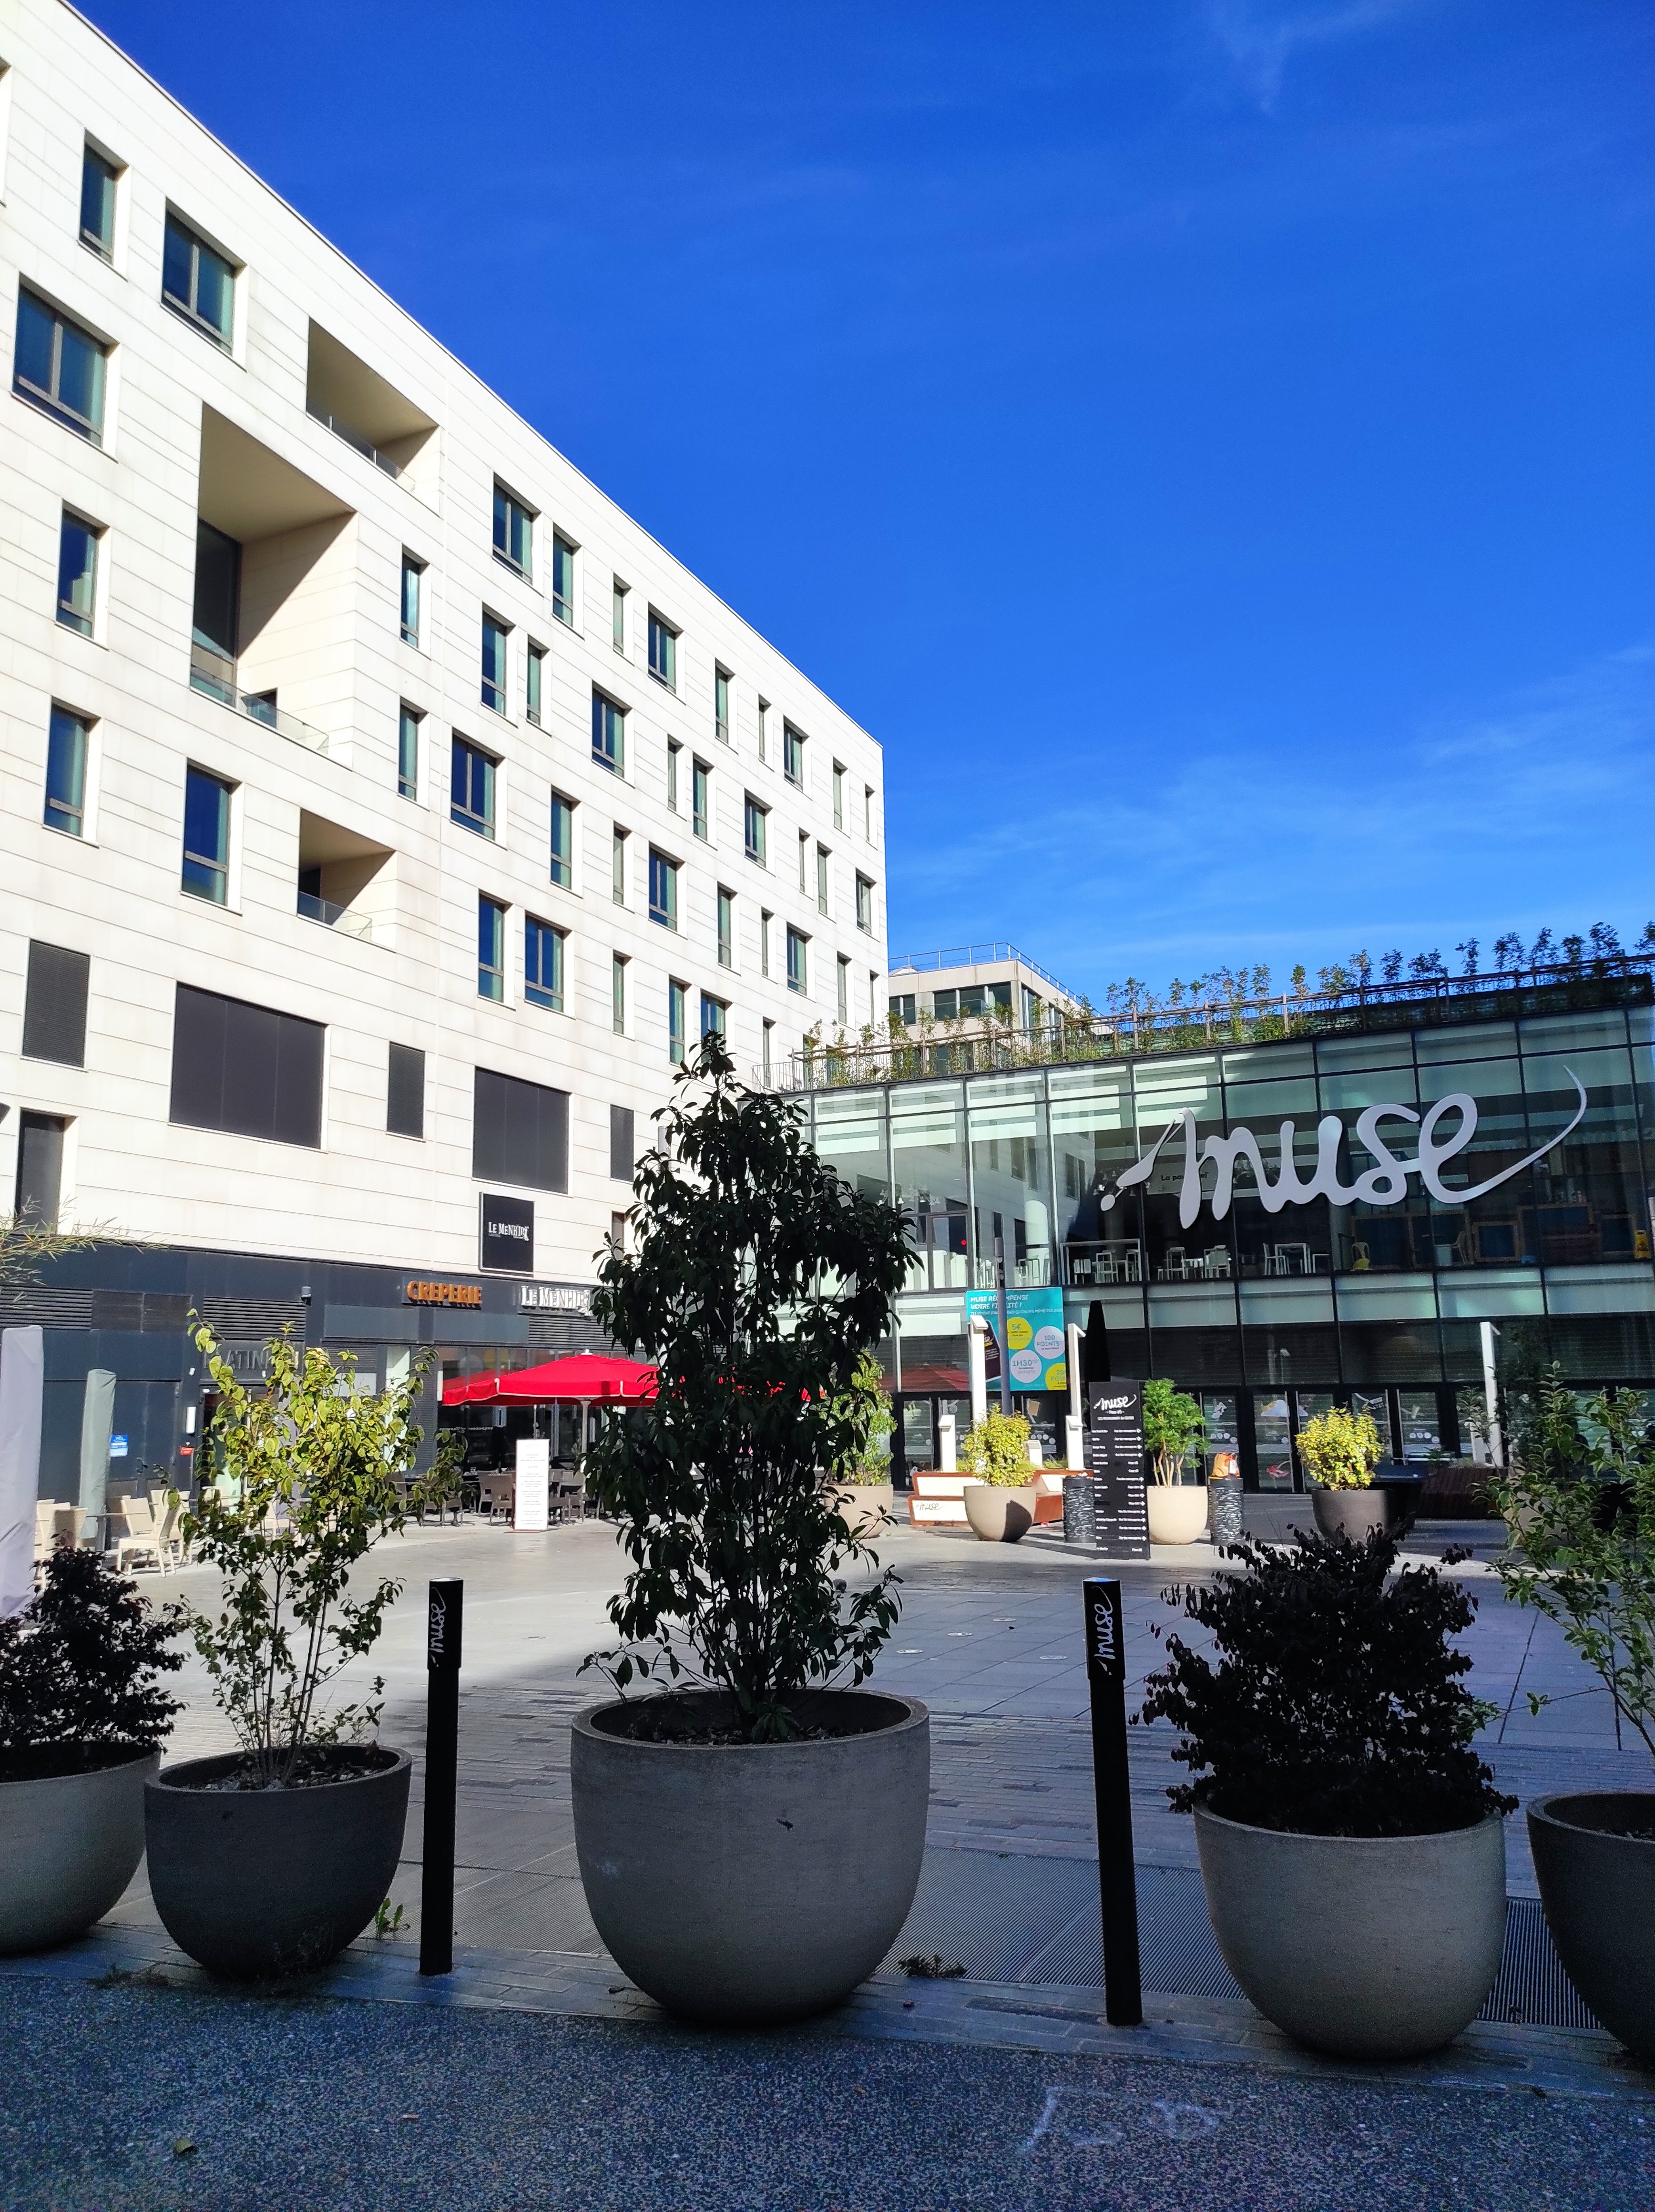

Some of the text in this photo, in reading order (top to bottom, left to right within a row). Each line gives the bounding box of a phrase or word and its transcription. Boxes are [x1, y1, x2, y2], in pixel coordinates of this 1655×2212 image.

[1101, 1065, 1587, 1229] muse
[407, 1280, 482, 1304] CREPERIE
[1093, 1393, 1137, 1411] muse
[428, 1587, 446, 1668] muse
[1091, 1586, 1116, 1676] muse
